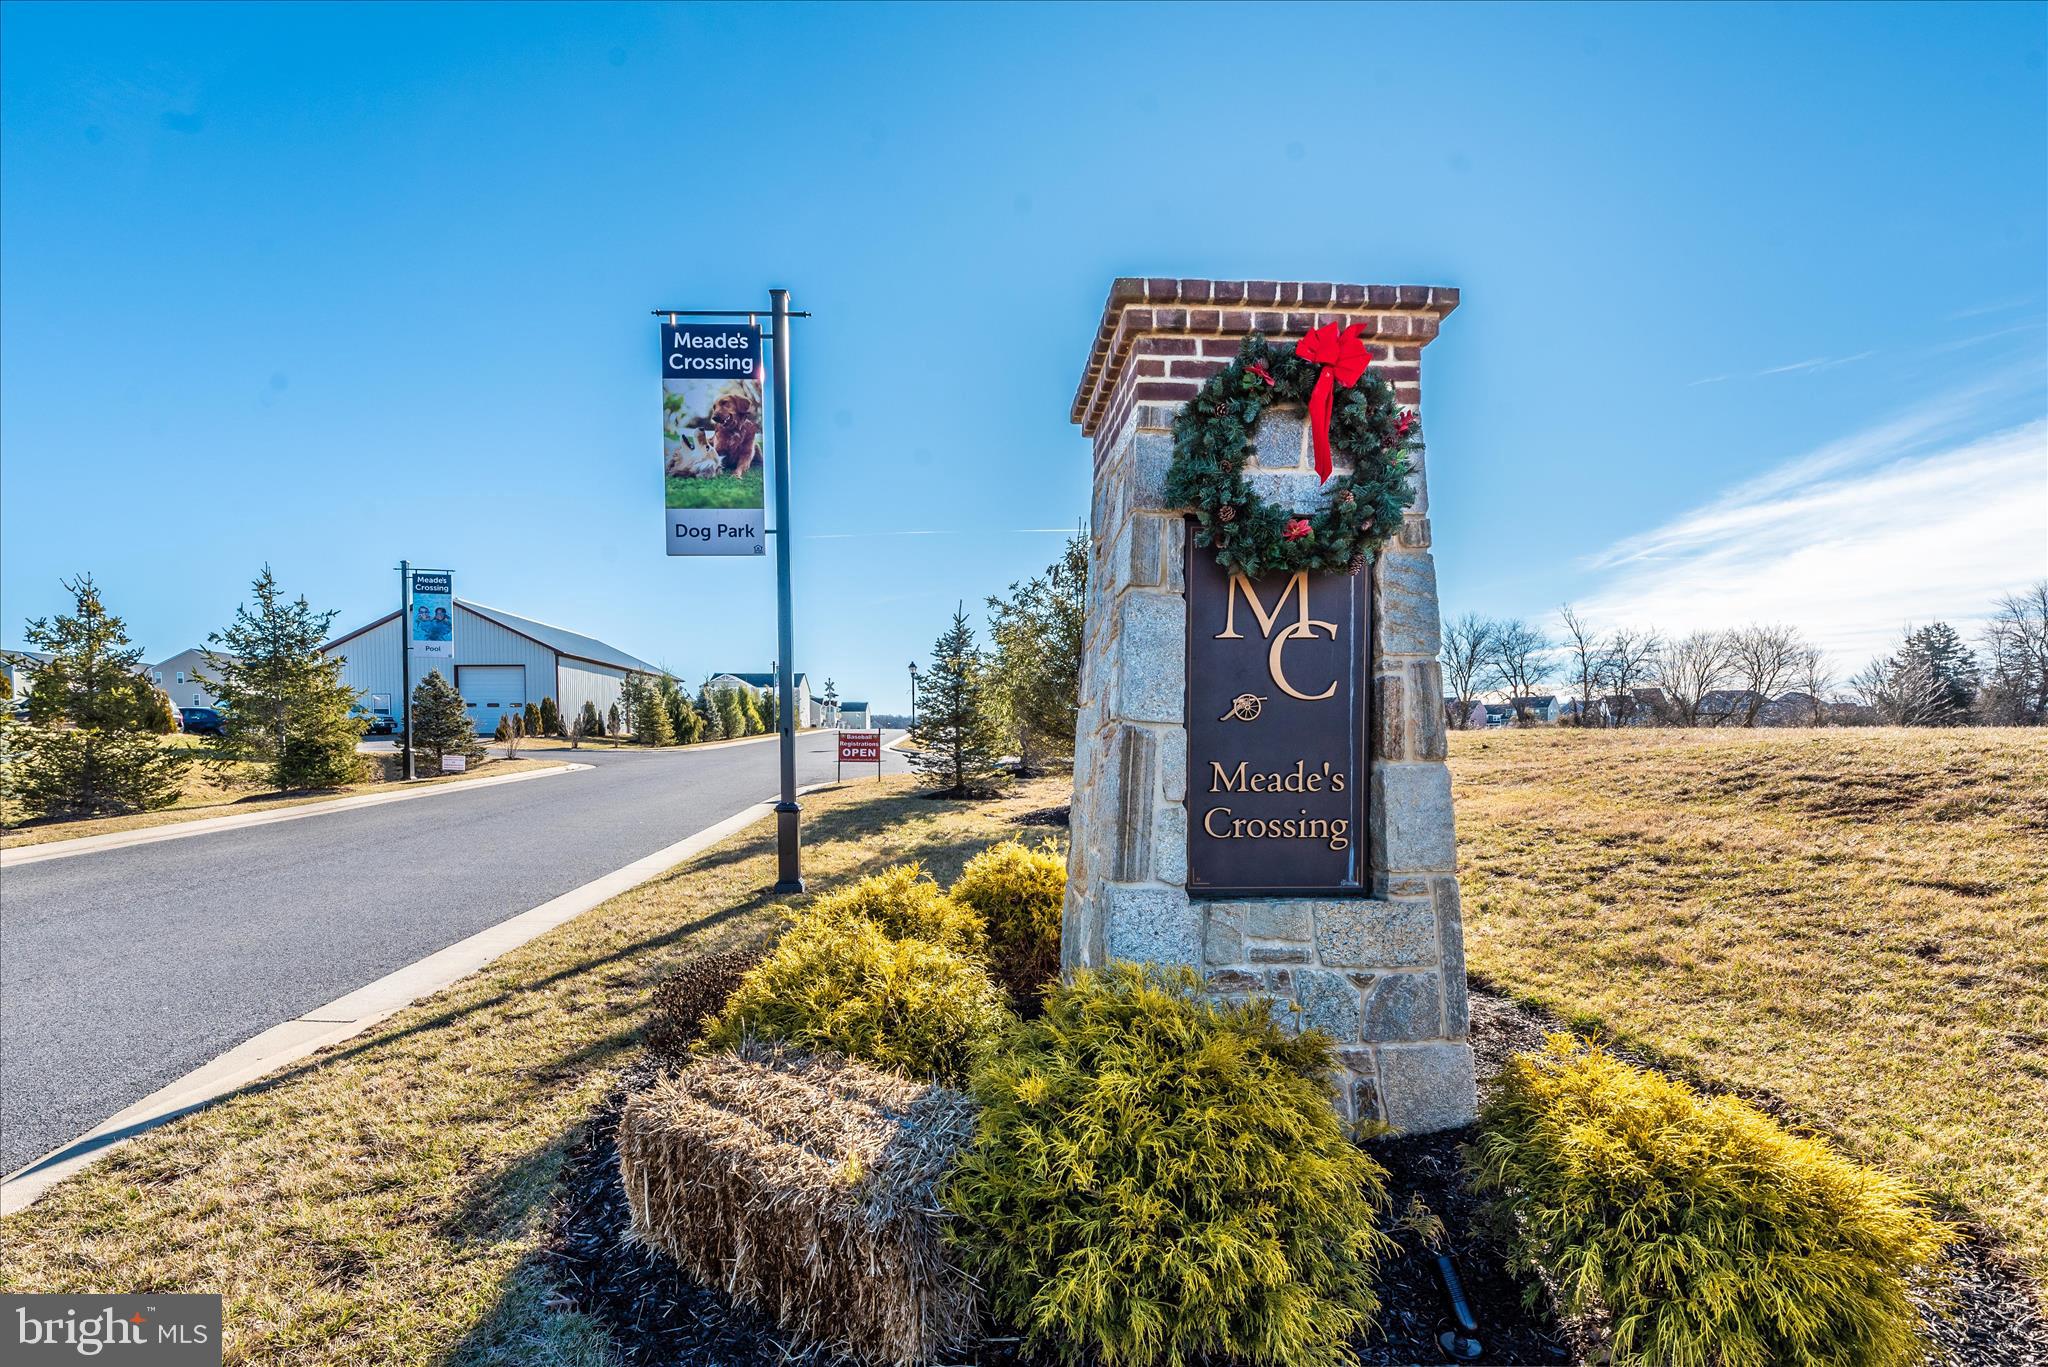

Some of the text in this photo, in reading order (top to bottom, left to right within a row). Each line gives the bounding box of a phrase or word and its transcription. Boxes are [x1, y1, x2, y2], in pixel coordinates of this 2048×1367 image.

[674, 332, 749, 349] Meade's
[669, 353, 754, 374] Crossing
[675, 523, 755, 541] Dog Park
[415, 584, 449, 593] Crossing
[417, 576, 447, 584] Meade's
[842, 748, 876, 757] OPEN
[1209, 760, 1345, 793] Meade's
[1203, 807, 1349, 850] Crossing
